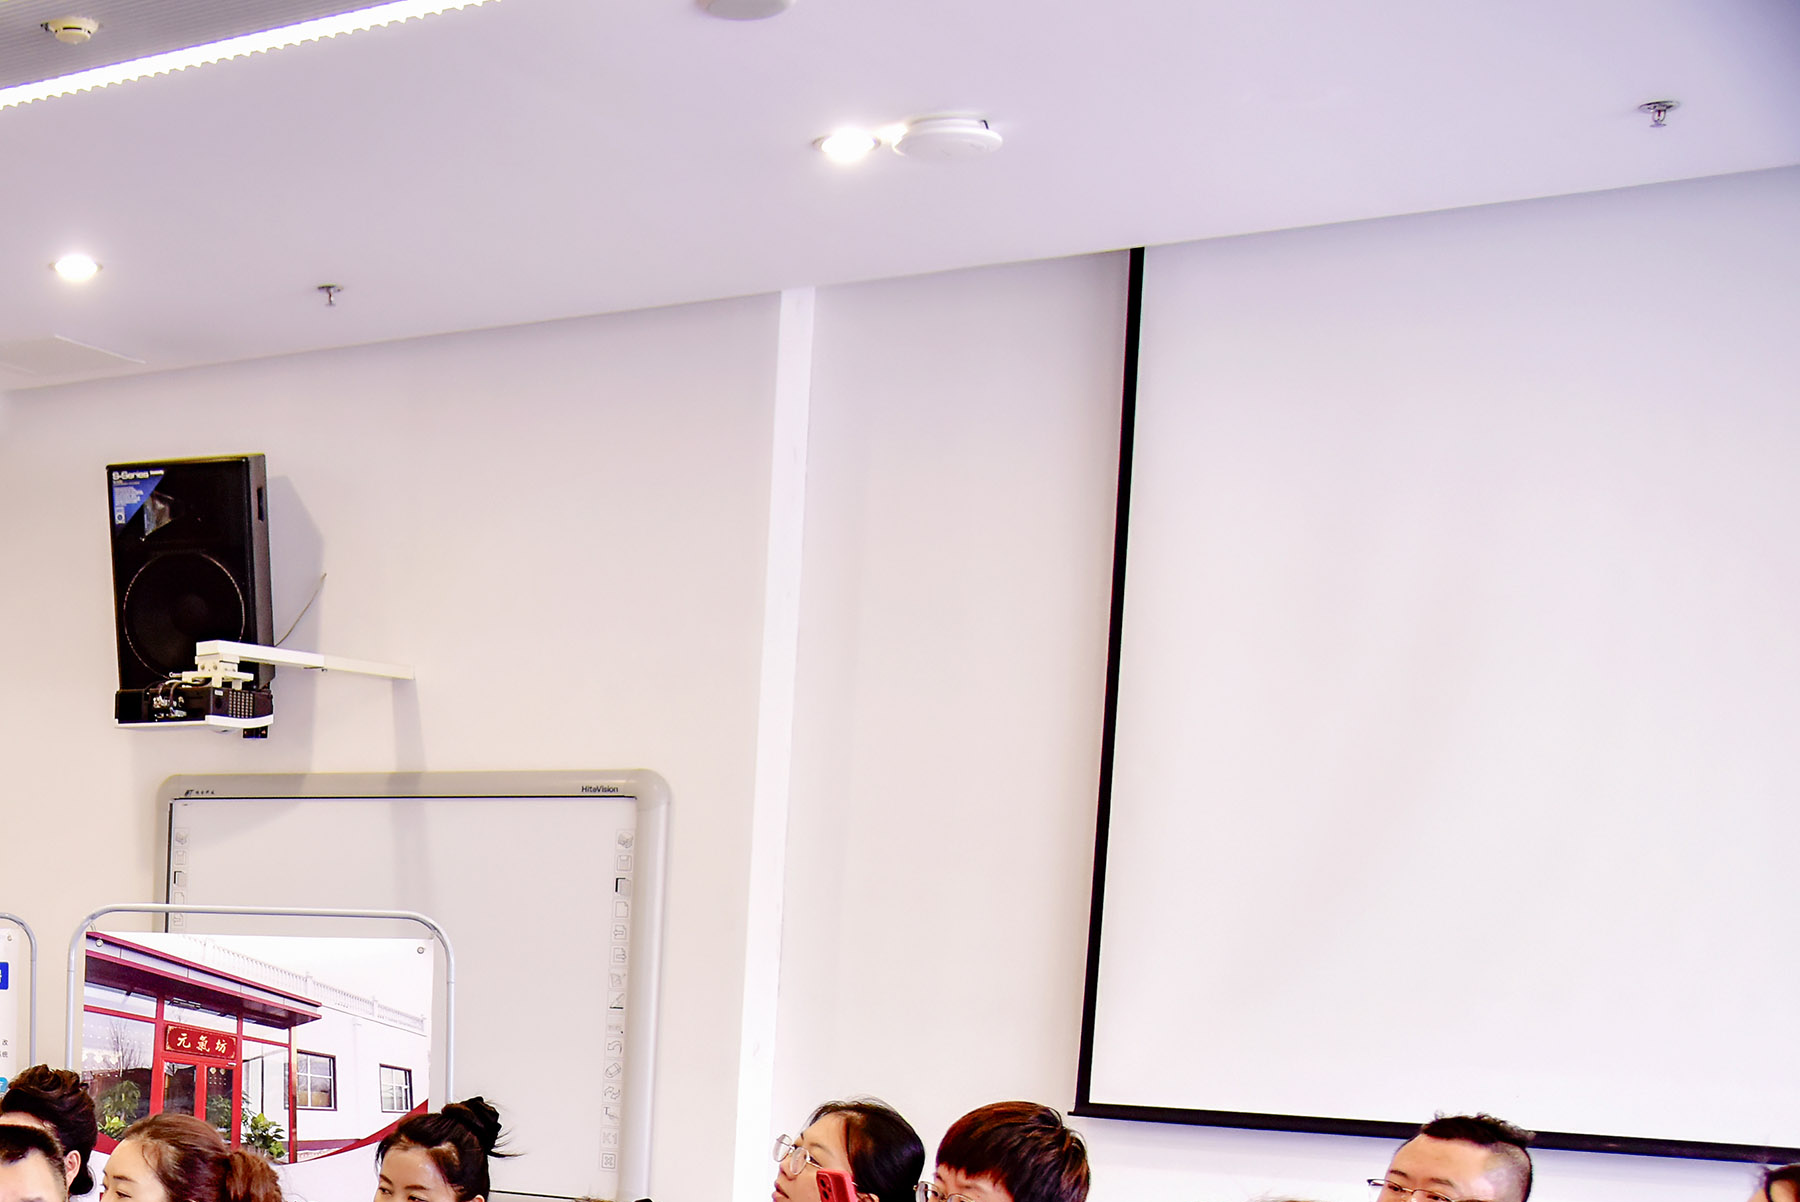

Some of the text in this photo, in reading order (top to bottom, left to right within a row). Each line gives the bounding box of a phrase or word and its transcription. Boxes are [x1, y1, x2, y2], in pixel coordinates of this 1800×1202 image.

[581, 785, 619, 793] HiteVision
[176, 1032, 228, 1054] 元氣坊
